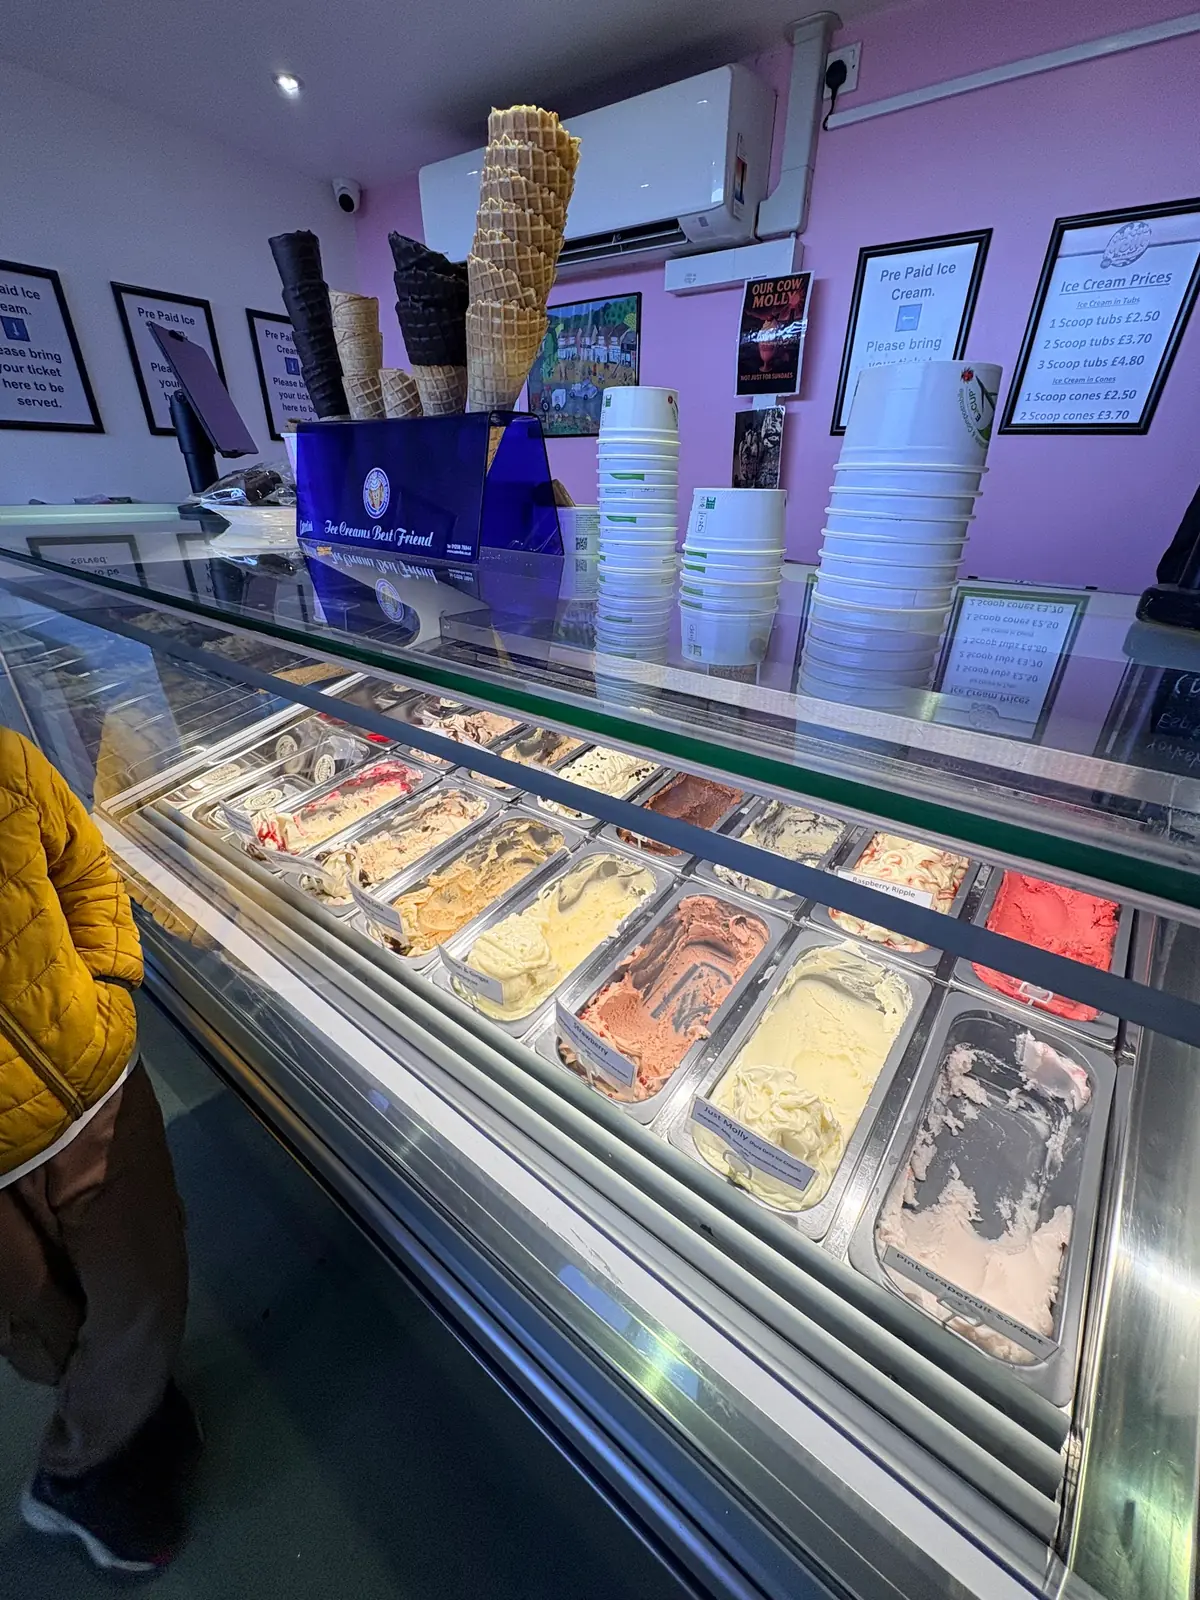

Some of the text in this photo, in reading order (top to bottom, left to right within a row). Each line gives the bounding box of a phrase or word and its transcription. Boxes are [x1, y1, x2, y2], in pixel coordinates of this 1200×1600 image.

[880, 262, 956, 282] Pre Paid Ice
[752, 278, 803, 295] OUR COW
[1060, 271, 1173, 293] Ice Cream Prices
[21, 287, 41, 300] Ice
[752, 291, 797, 308] MOLLY
[891, 287, 935, 301] Cream.
[1123, 297, 1140, 305] Tubs
[137, 307, 195, 326] Pre Paid Ice
[1049, 310, 1161, 328] 1 Scoop tubs £2.50
[265, 329, 293, 342] Pre Pai
[1043, 333, 1153, 350] 2 Scoop tubs £3.70
[866, 337, 942, 353] Please bring
[28, 347, 62, 364] bring
[1037, 355, 1145, 371] 3 Scoop tubs £4.80
[27, 364, 62, 377] ticket
[150, 362, 172, 373] Plea
[2, 378, 64, 393] here to be
[273, 377, 298, 388] Please
[1087, 376, 1094, 384] in
[1095, 375, 1116, 384] Cones
[17, 396, 62, 408] served.
[279, 391, 296, 400] your
[1024, 389, 1137, 403] 1 Scoop cones £2.50
[282, 402, 298, 412] here
[299, 404, 307, 412] to
[1019, 410, 1130, 422] 2 Scoop cones £3.70
[324, 519, 338, 535] Ice
[339, 523, 371, 540] Creams
[372, 525, 394, 542] Best
[394, 527, 434, 547] Friend
[852, 876, 916, 898] Raspberry Ripple
[573, 1022, 609, 1056] Strawberry
[703, 1106, 721, 1120] Just
[723, 1119, 749, 1141] Molly
[896, 1252, 1045, 1347] Pink Grapefruit Sorbet
